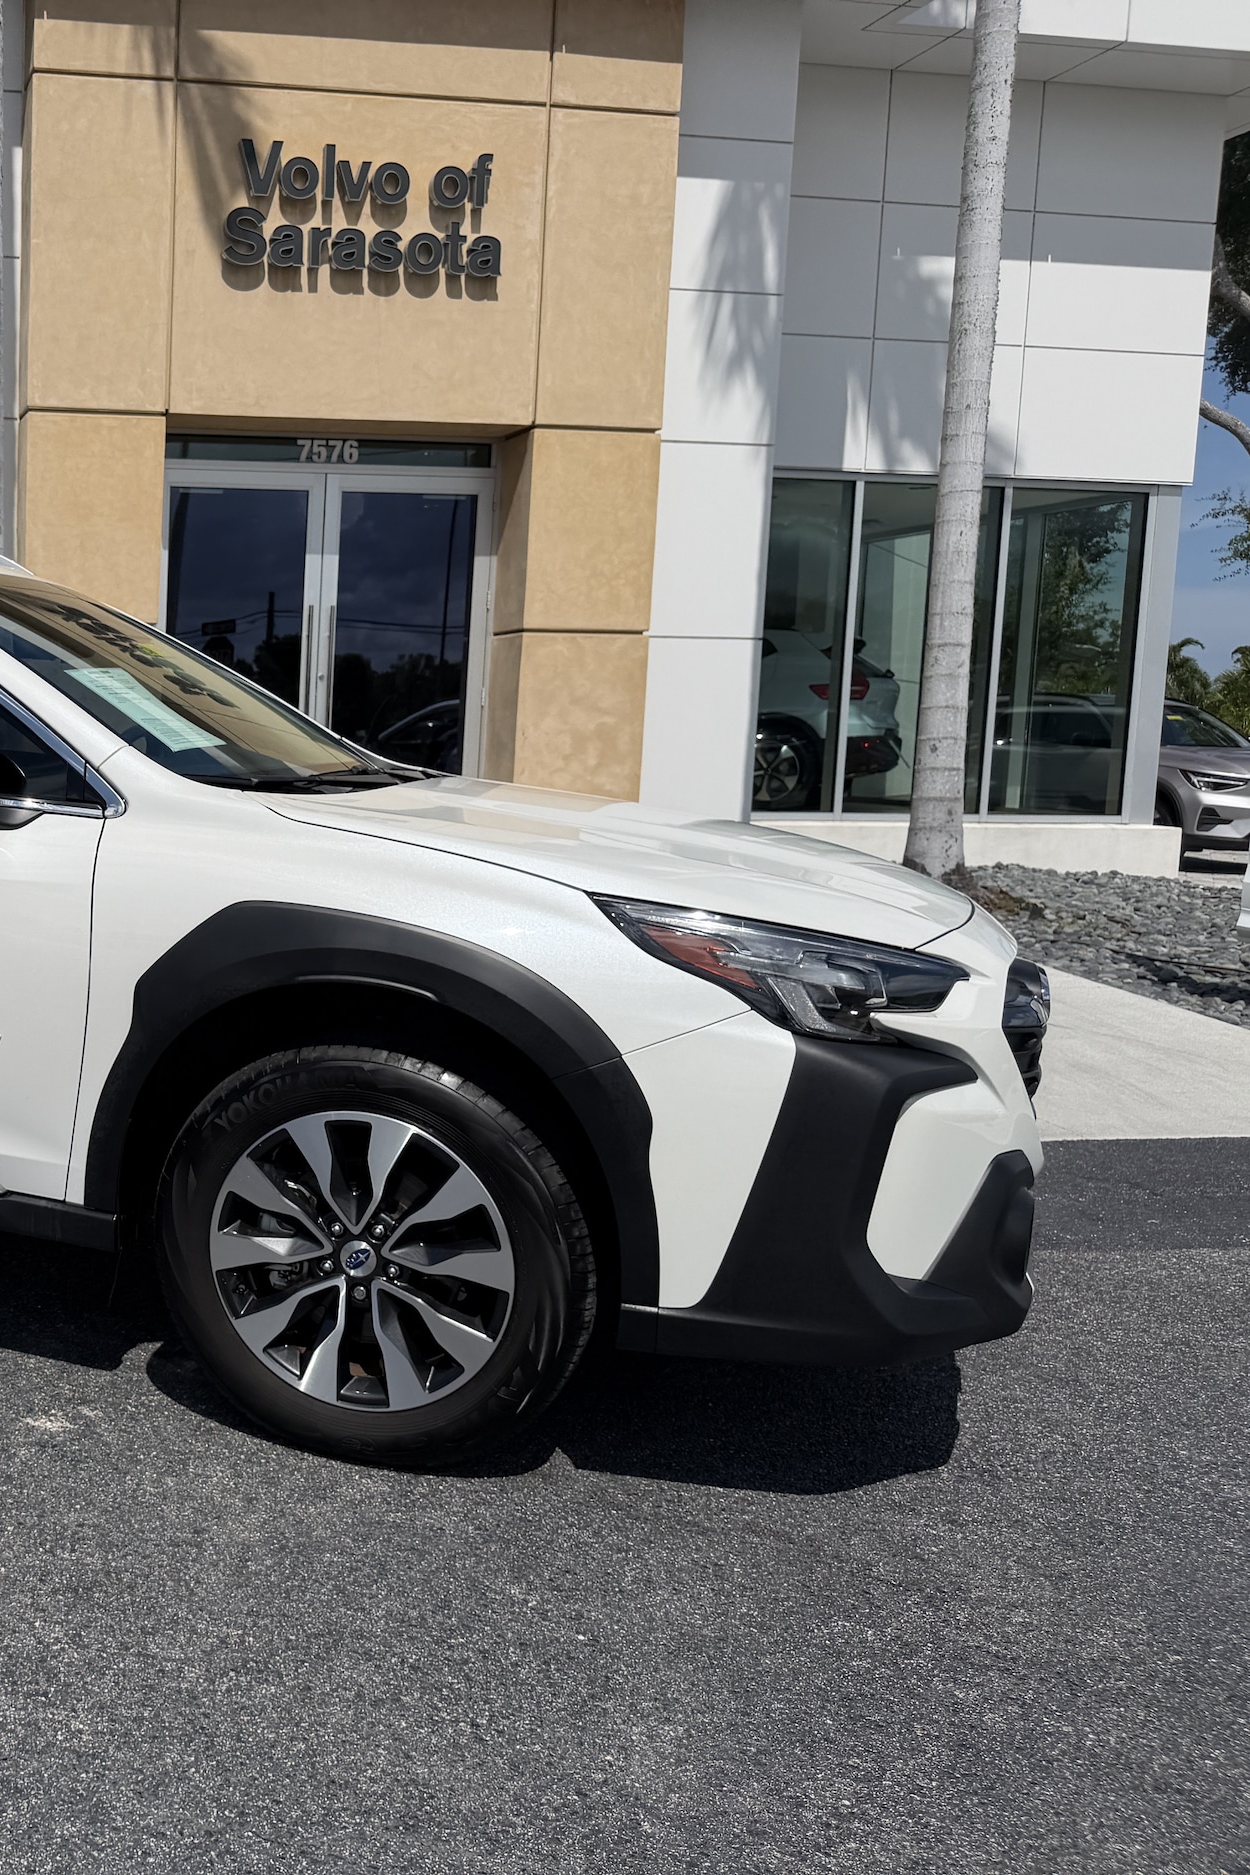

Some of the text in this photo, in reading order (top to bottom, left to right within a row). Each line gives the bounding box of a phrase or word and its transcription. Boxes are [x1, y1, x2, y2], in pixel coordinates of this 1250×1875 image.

[238, 138, 494, 209] Volvo of
[221, 206, 502, 278] Sarasota
[296, 439, 360, 465] 7576
